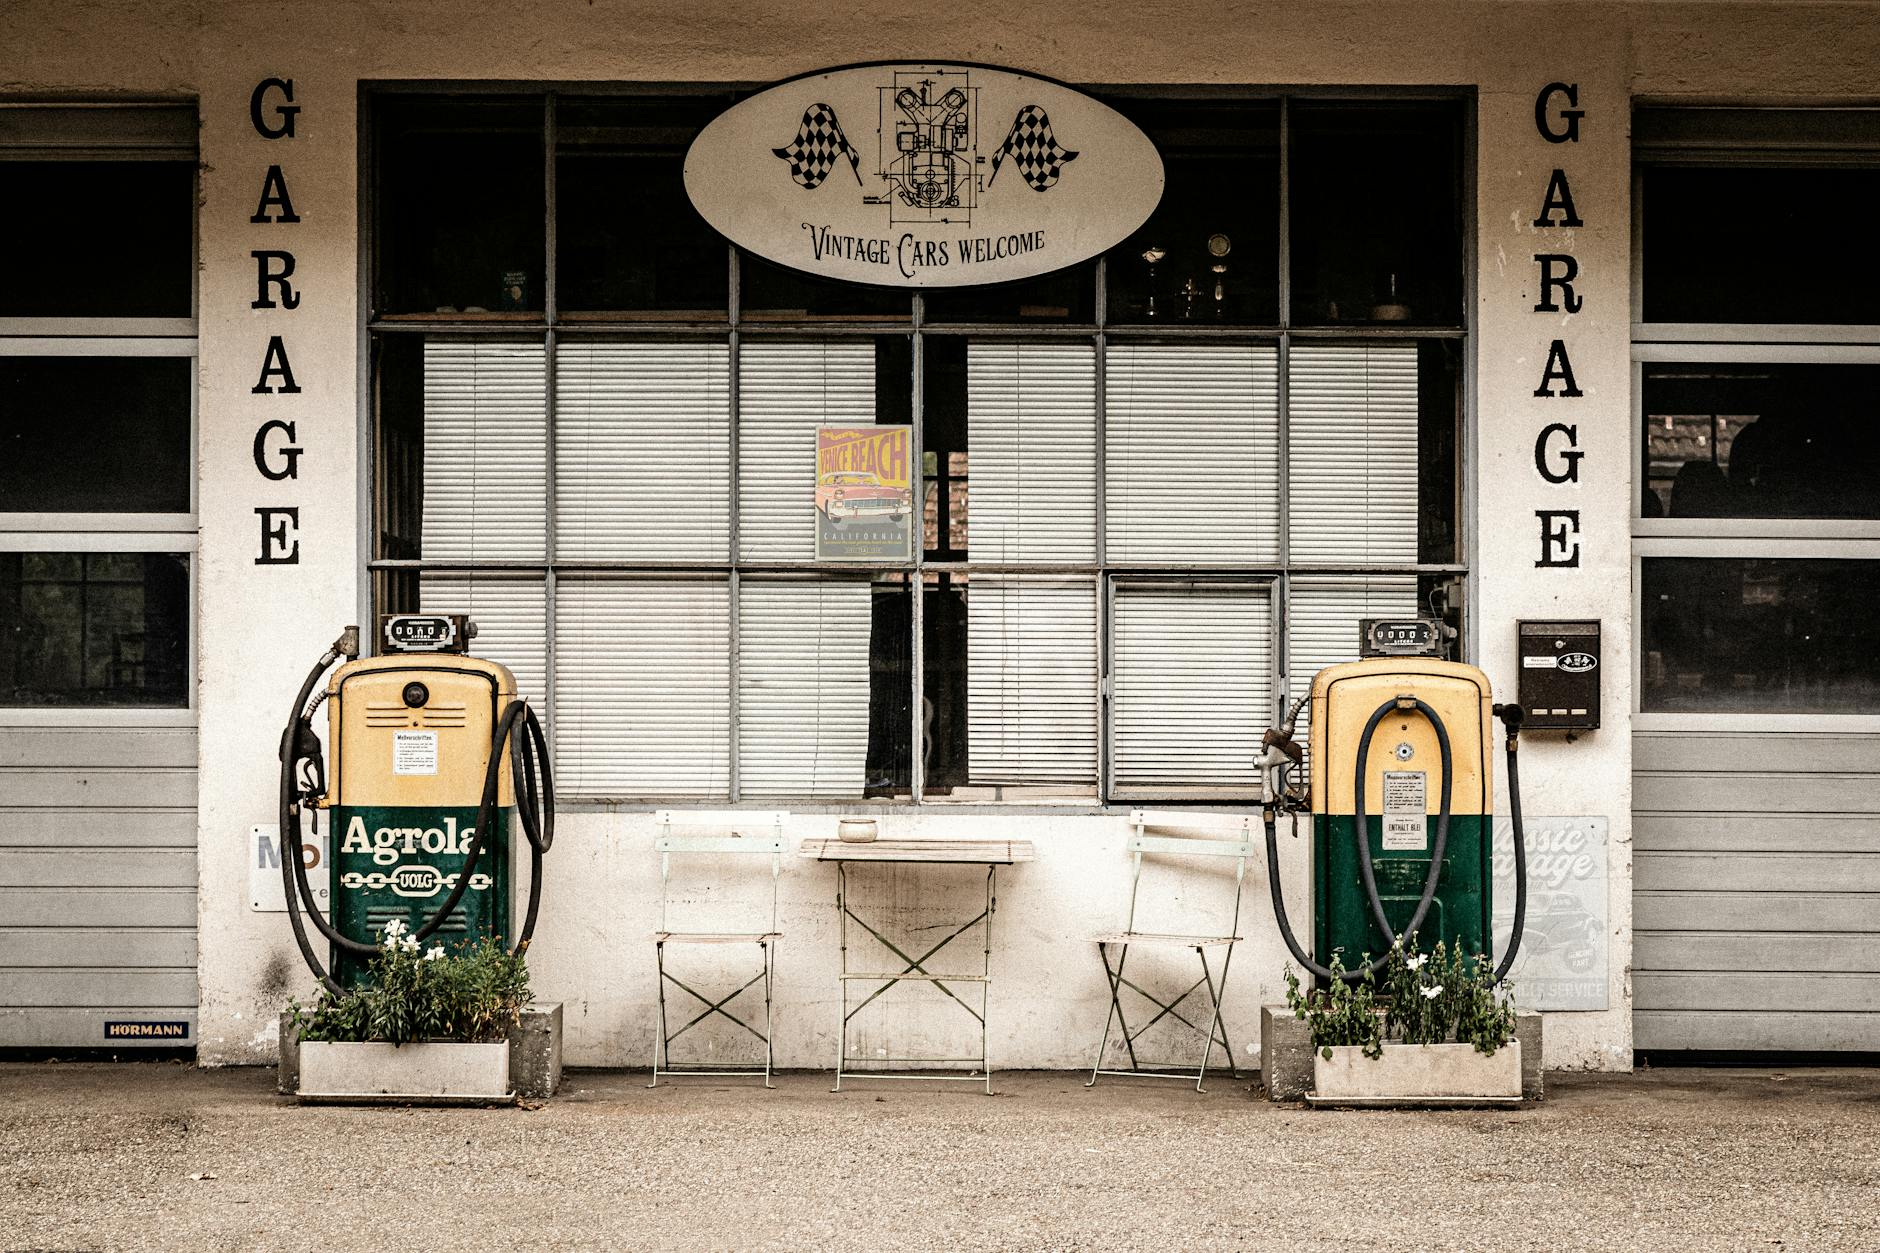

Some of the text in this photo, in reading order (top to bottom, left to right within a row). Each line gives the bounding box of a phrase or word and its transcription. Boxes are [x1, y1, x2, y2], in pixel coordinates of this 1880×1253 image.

[801, 222, 1046, 280] VINTAGE CARS WELCOME
[250, 77, 304, 565] GARAGE
[1533, 82, 1585, 568] GARAGE
[851, 431, 907, 480] BEACH
[823, 531, 903, 540] CALIFORNIA
[1493, 821, 1586, 854] lassic
[110, 1024, 183, 1036] HÖRMANN
